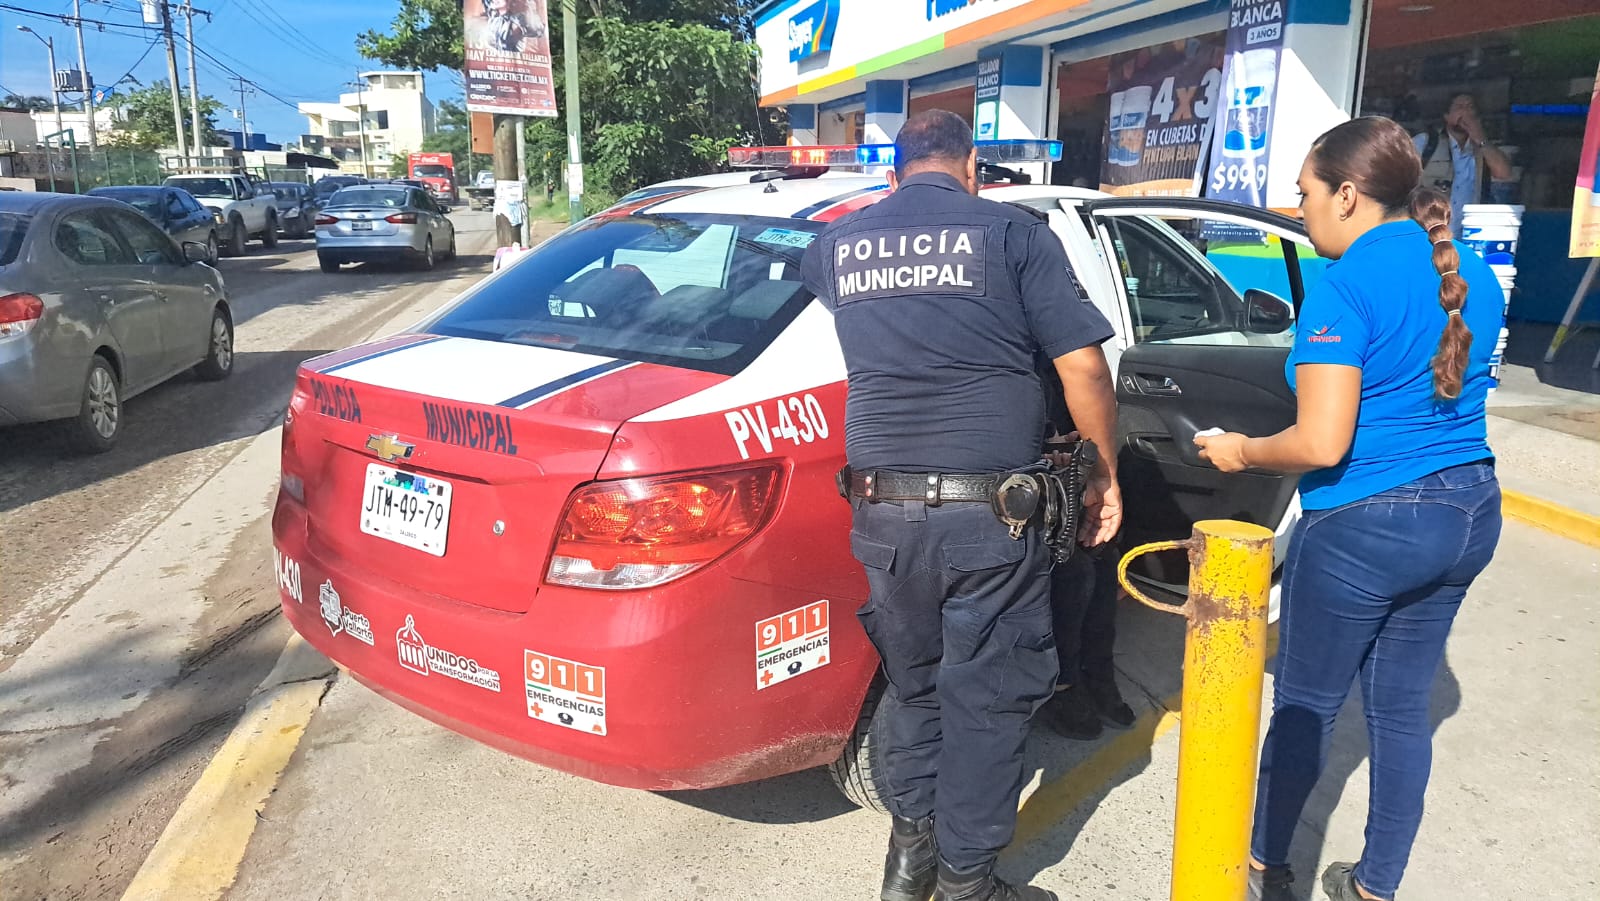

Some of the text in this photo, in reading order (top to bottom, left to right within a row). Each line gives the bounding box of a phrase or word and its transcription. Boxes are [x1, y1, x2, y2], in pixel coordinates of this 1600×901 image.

[1231, 1, 1282, 28] BLANCA
[790, 17, 813, 55] Sayer
[1251, 27, 1277, 40] 3 AÑOS
[978, 74, 999, 88] BLANCO
[1145, 129, 1159, 147] EN
[1160, 123, 1197, 146] CUBETAS
[1176, 143, 1200, 161] BLAN
[838, 229, 973, 266] POLICÍA
[838, 264, 973, 297] MUNICIPAL
[310, 378, 518, 455] POLICÍA MUNICIPAL
[724, 393, 829, 460] PV-430
[365, 484, 444, 530] JTM-49-79
[342, 618, 373, 639] Vallarta
[344, 607, 369, 628] Puerto
[762, 607, 821, 645] 911
[427, 646, 478, 674] UNIDOS
[478, 668, 489, 676] POR
[758, 637, 829, 669] EMERGENCIAS
[430, 661, 499, 689] TRANSFORMACIÓN
[531, 658, 594, 692] 911
[527, 689, 604, 716] EMERGENCIAS
